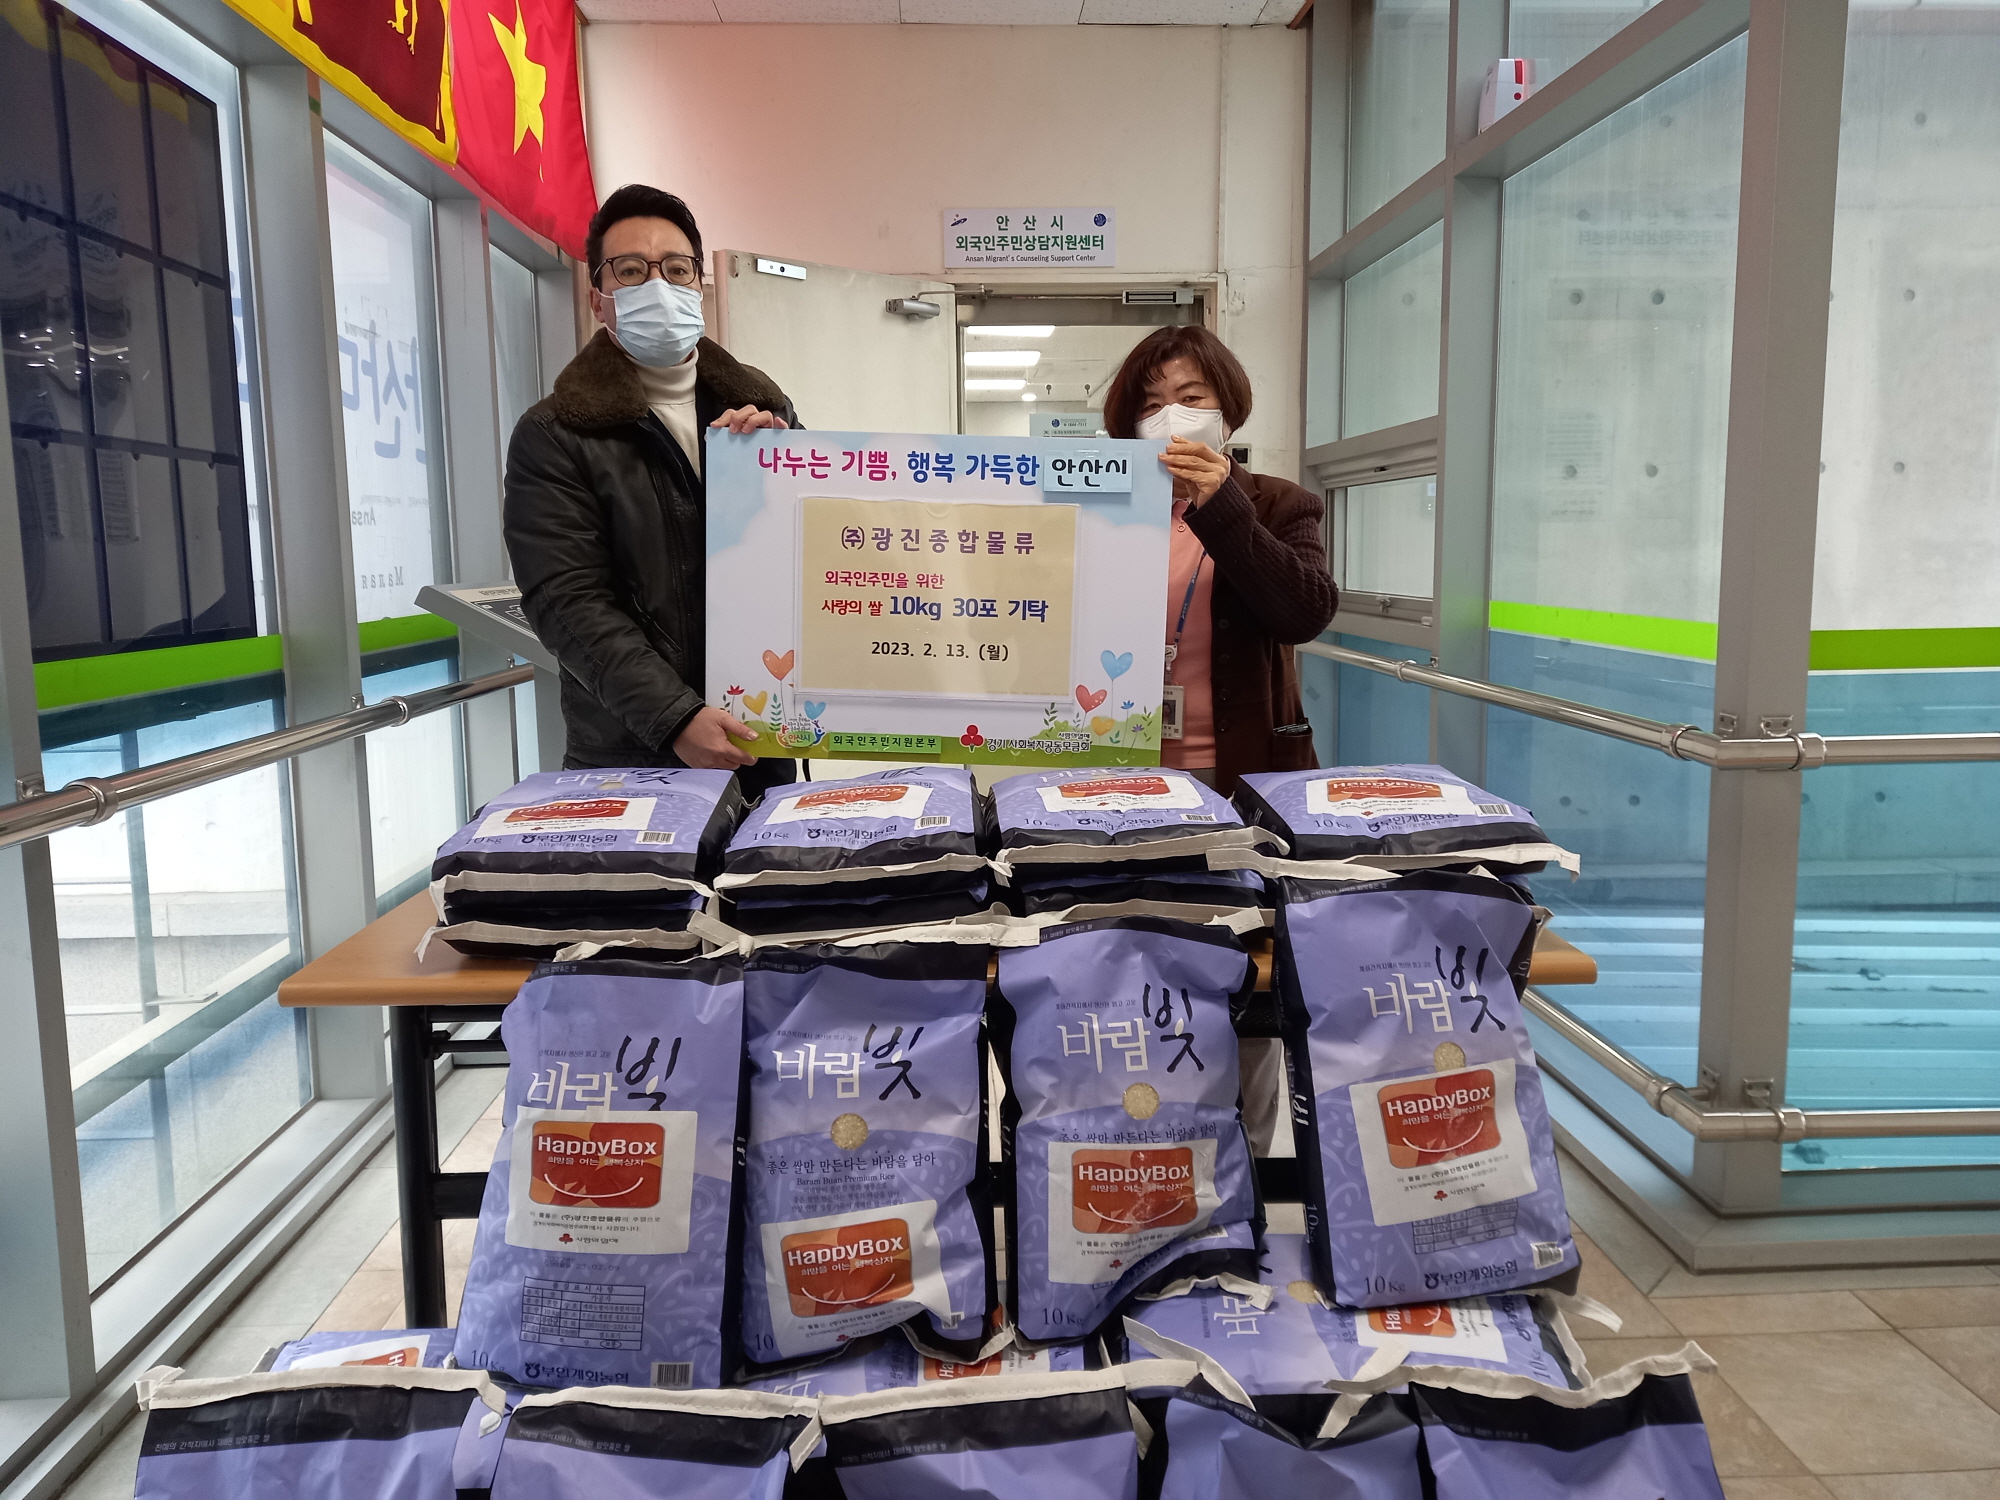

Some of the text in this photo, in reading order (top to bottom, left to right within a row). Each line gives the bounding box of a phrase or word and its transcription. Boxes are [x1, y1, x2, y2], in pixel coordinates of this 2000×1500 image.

[955, 234, 1105, 251] 외국인주민상담지원센터
[1016, 254, 1049, 263] Counseling
[1050, 254, 1075, 263] Support
[1075, 254, 1096, 262] Center
[758, 447, 1040, 486] 나누는 기쁨, 행복 가득한
[1051, 459, 1128, 487] 안산시
[825, 570, 945, 590] 외국인주민을 위한
[821, 595, 1049, 623] 사랑의 쌀 10kg 30포 기탁
[871, 641, 1009, 662] 2023. 2. 13. (월)
[833, 735, 937, 748] 외국인주민지원본부
[1008, 739, 1090, 754] 사회복지공동모금회
[1386, 1085, 1491, 1117] HappyBox
[538, 1136, 657, 1156] HappyBox
[767, 1152, 937, 1175] 좋은 쌀만 만든다는 바람을 담아
[1078, 1164, 1192, 1183] HappyBox
[845, 1174, 877, 1183] Premium
[787, 1236, 904, 1266] HappyBox
[1440, 1259, 1519, 1286] 부안계화농협
[541, 1367, 629, 1383] 부안계화농협
